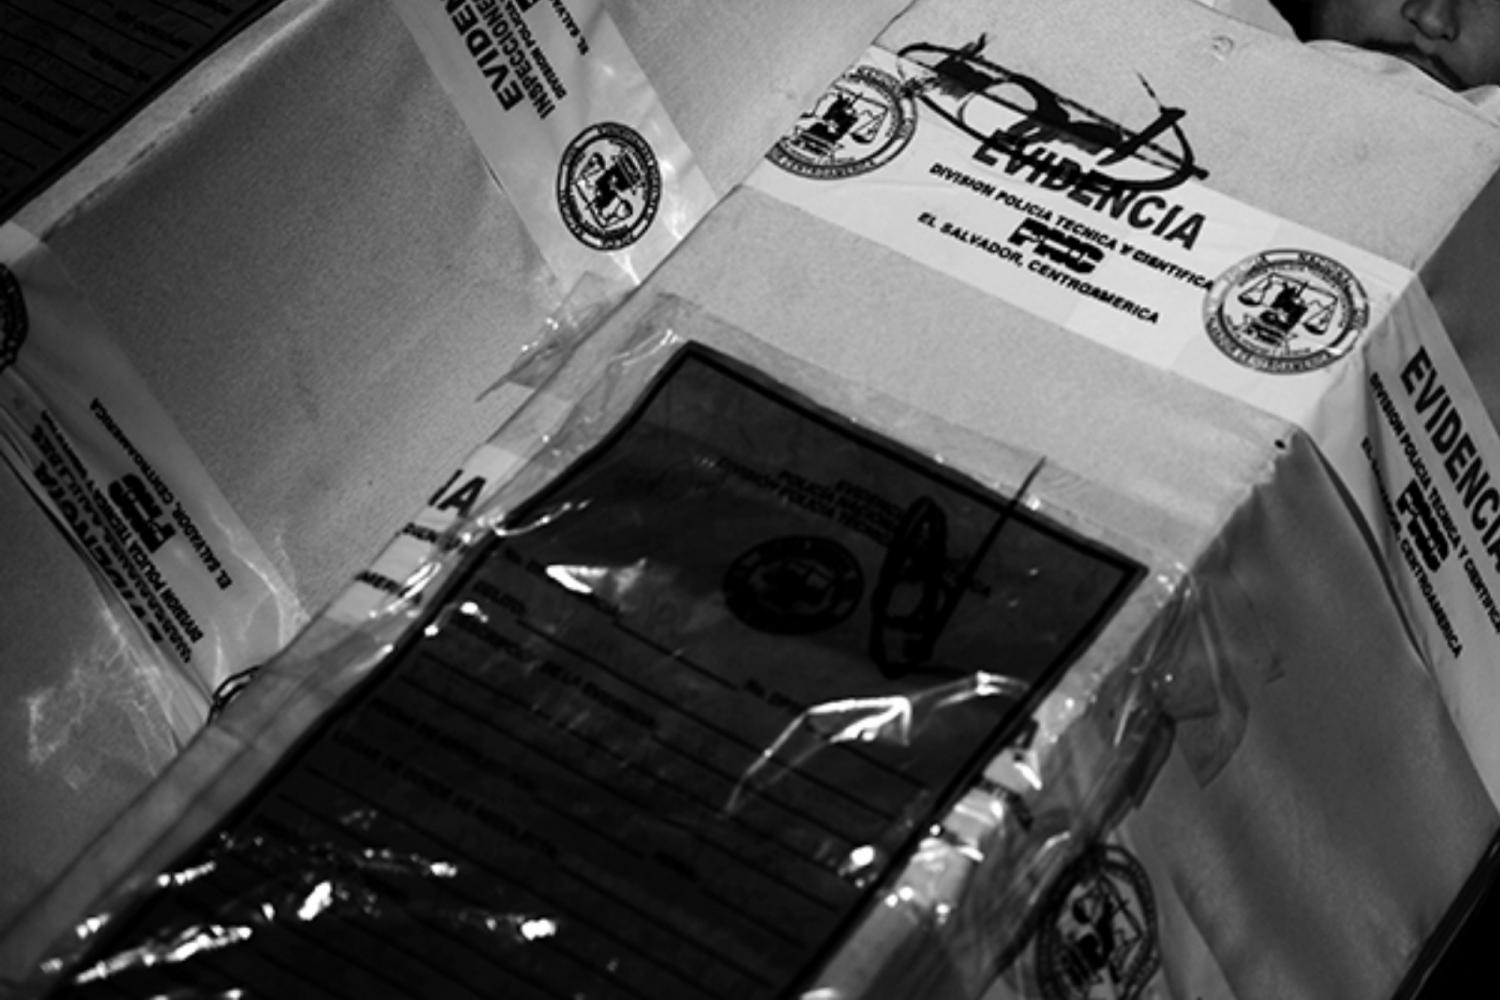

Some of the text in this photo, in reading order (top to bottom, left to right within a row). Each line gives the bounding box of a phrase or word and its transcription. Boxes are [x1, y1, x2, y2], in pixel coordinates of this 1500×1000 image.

[929, 162, 996, 197] DIVISION
[994, 190, 1053, 222] POLICIA
[1055, 215, 1118, 251] TECNICA
[972, 129, 1206, 251] EVIDENCIA
[917, 211, 1159, 324] EL SALVADOR, CENTROAMERICA
[1399, 432, 1432, 490] POLICIA
[1420, 486, 1462, 549] TECNICA
[1457, 546, 1469, 559] Y
[216, 569, 233, 590] EL
